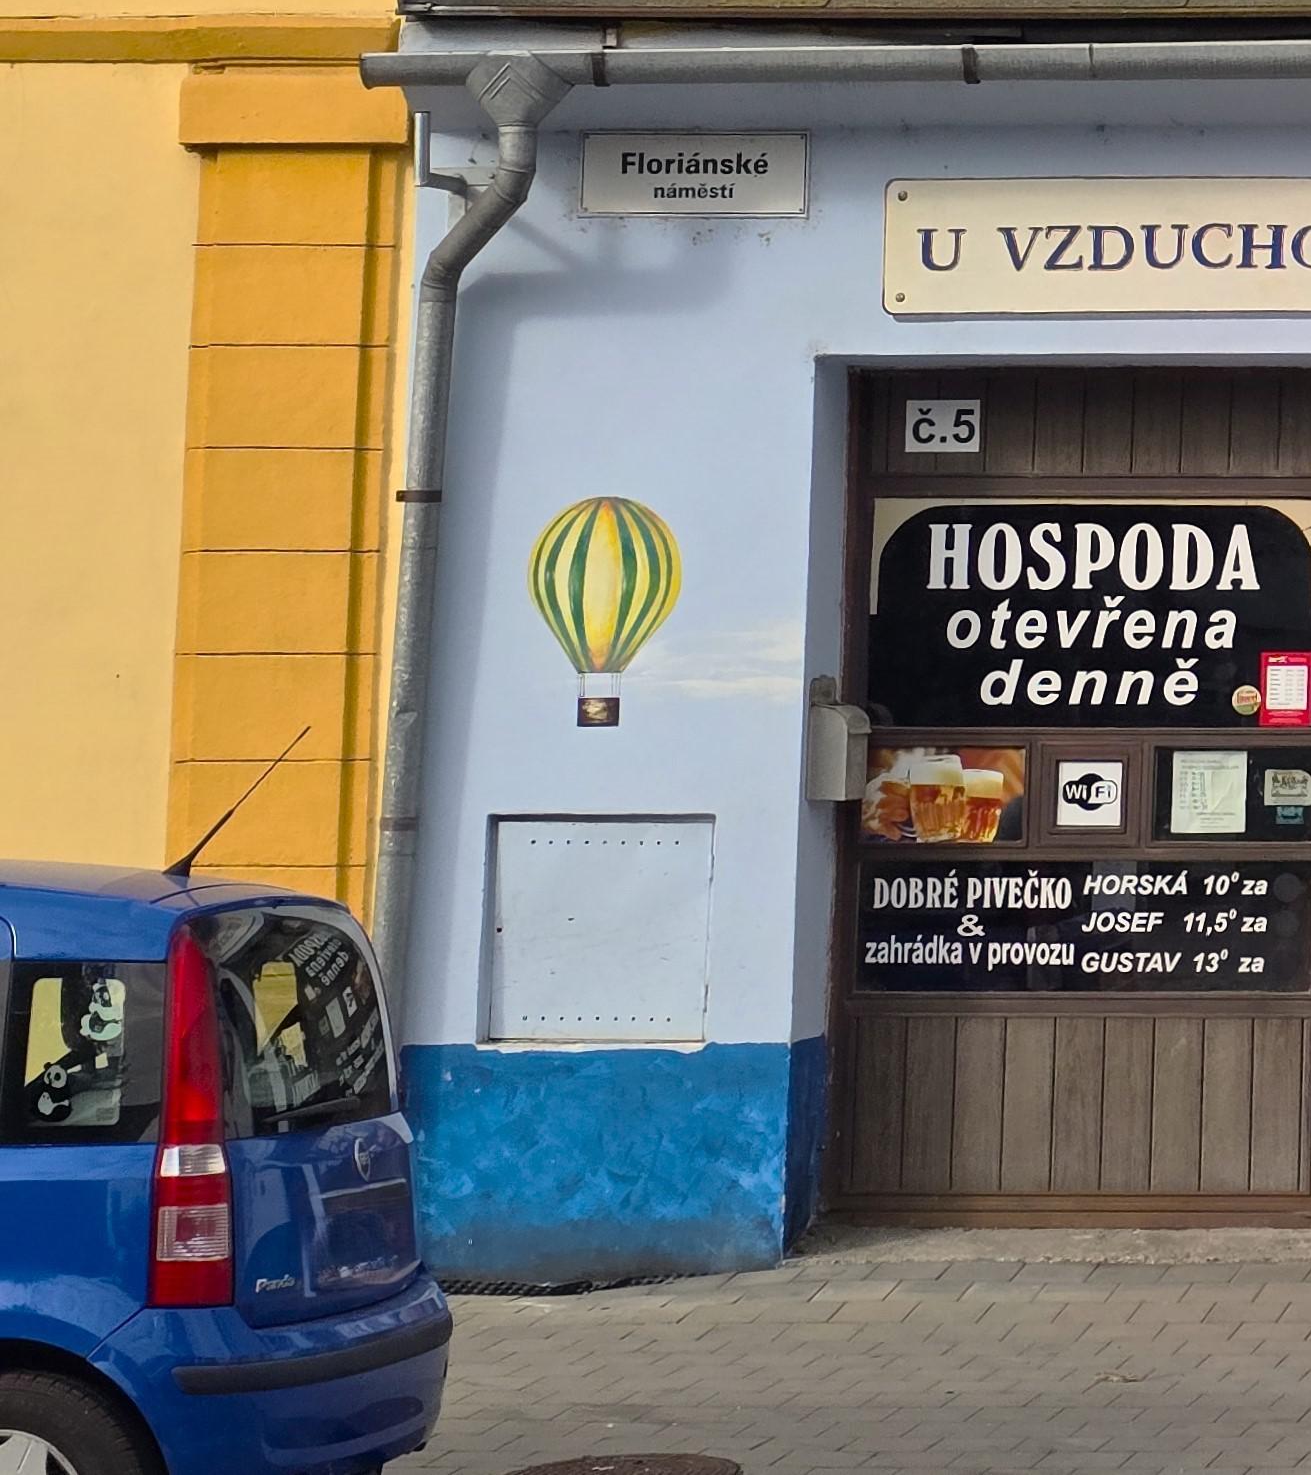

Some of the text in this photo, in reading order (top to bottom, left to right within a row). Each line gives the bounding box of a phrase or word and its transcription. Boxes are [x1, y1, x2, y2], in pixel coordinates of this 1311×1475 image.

[620, 151, 768, 176] Floriánské
[653, 182, 734, 200] náměstí
[917, 228, 966, 271] U
[912, 408, 976, 444] č.5
[926, 522, 1261, 591] HOSPODA
[946, 596, 1238, 649] otevřena
[980, 658, 1199, 706] denně
[873, 869, 1073, 910] DOBRÉ PIVEČKO
[1083, 870, 1188, 896] HORSKÁ
[1242, 878, 1269, 896] za
[957, 915, 986, 937] &
[1081, 912, 1164, 933] JOSEF
[1241, 916, 1268, 933] za
[865, 935, 1075, 971] zahrádka v provozu
[1081, 951, 1182, 974] GUSTAV
[1238, 956, 1265, 973] za
